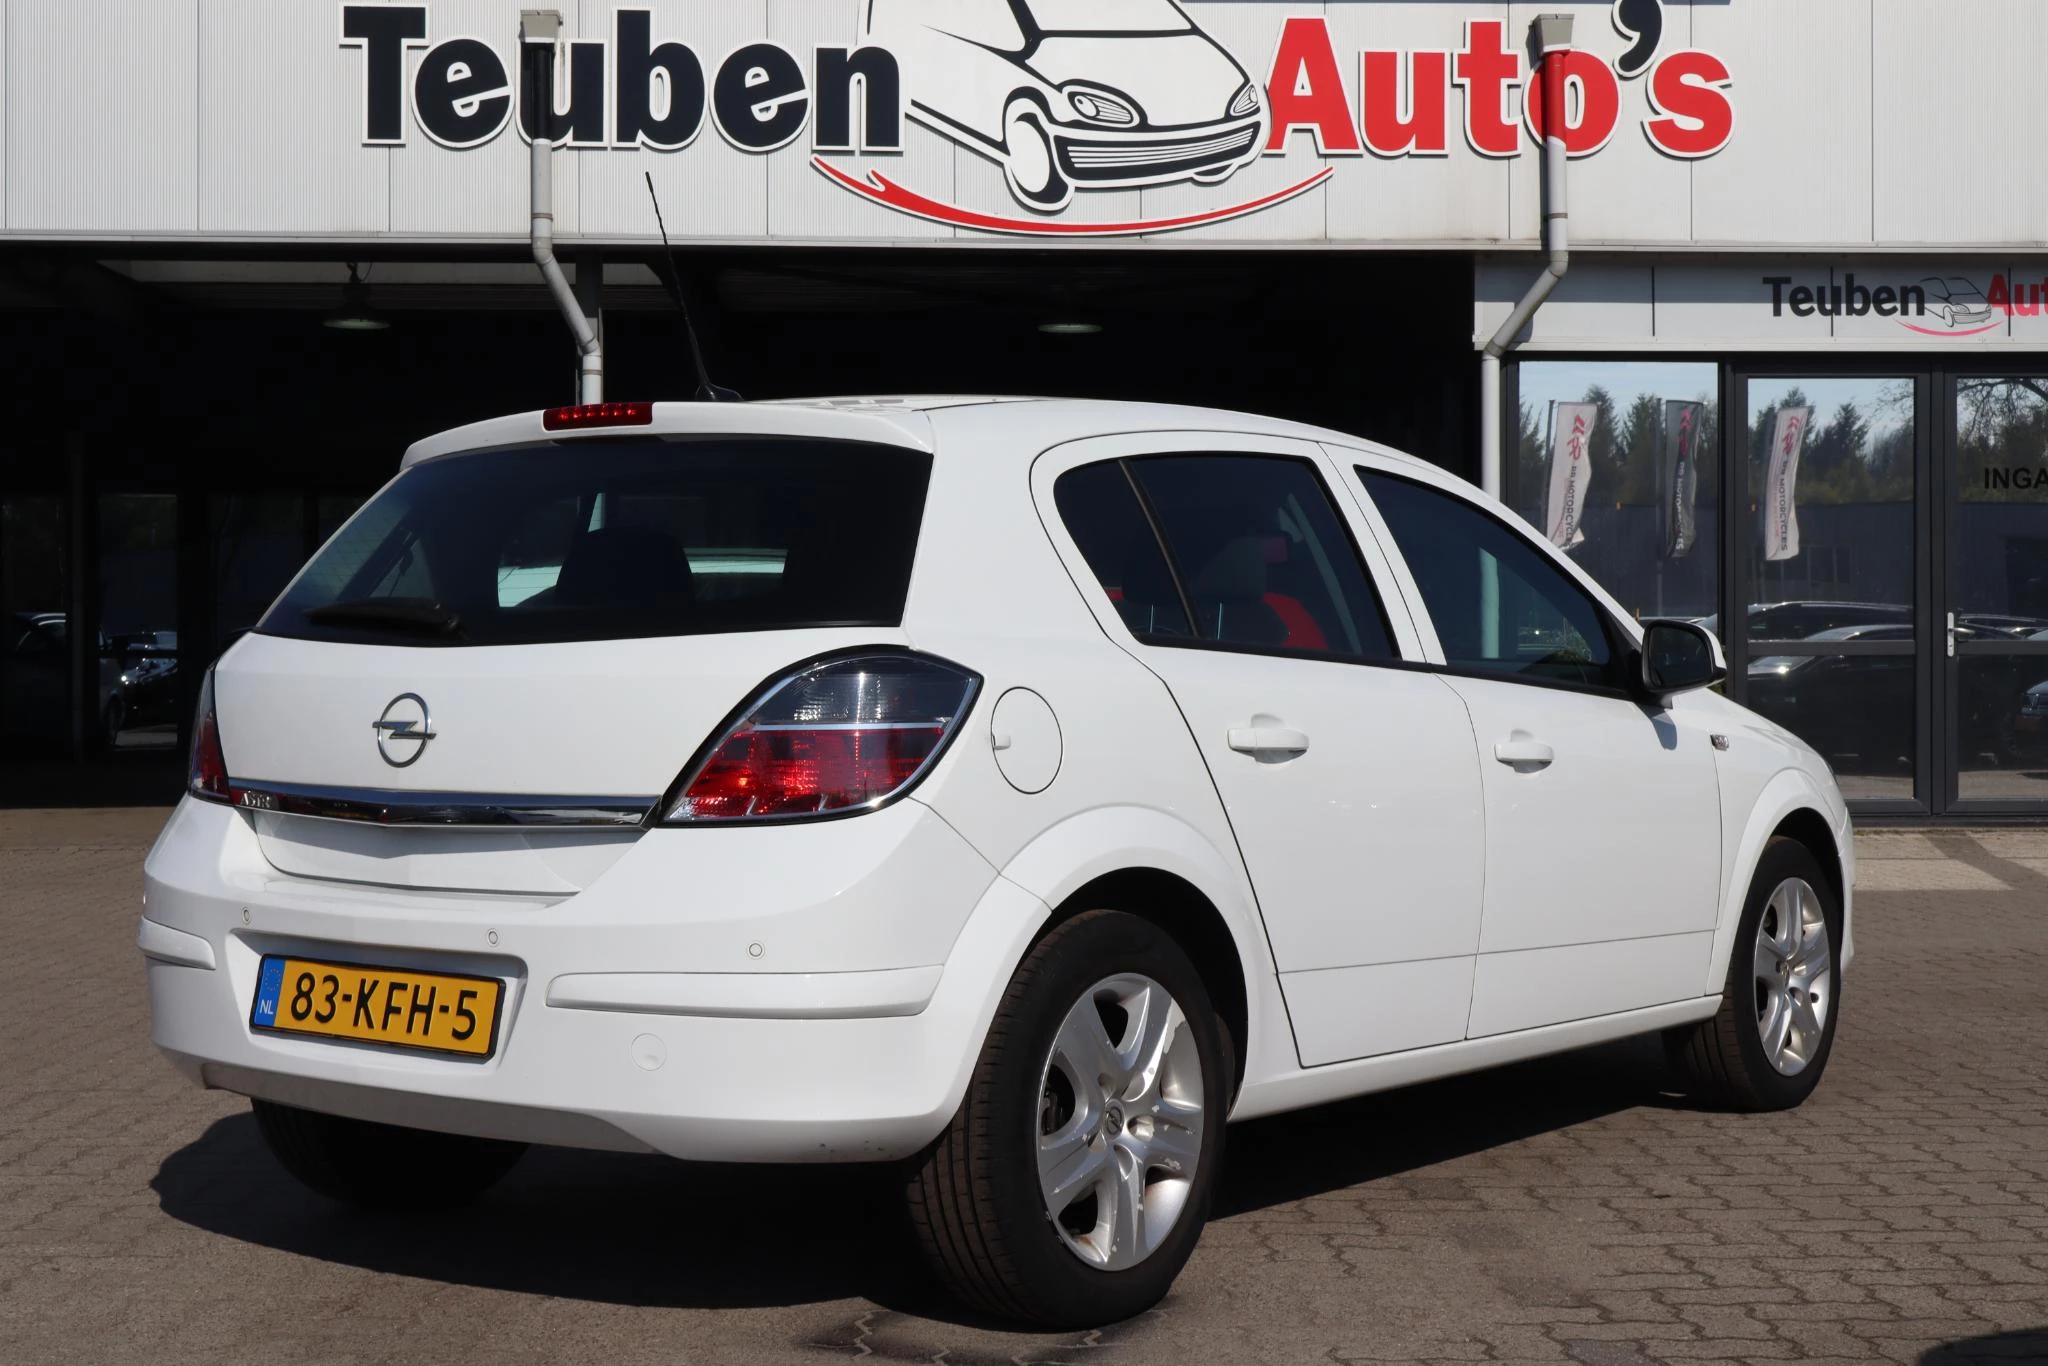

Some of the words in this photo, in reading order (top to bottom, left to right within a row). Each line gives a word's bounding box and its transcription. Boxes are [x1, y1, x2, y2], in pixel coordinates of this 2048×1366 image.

[341, 4, 903, 152] Teuben
[1263, 0, 1734, 157] Auto's
[1762, 273, 1925, 317] Teuben
[1779, 478, 1788, 551] MOTORCYCLES
[259, 999, 274, 1015] NL
[290, 972, 478, 1040] 83-KFH-5
